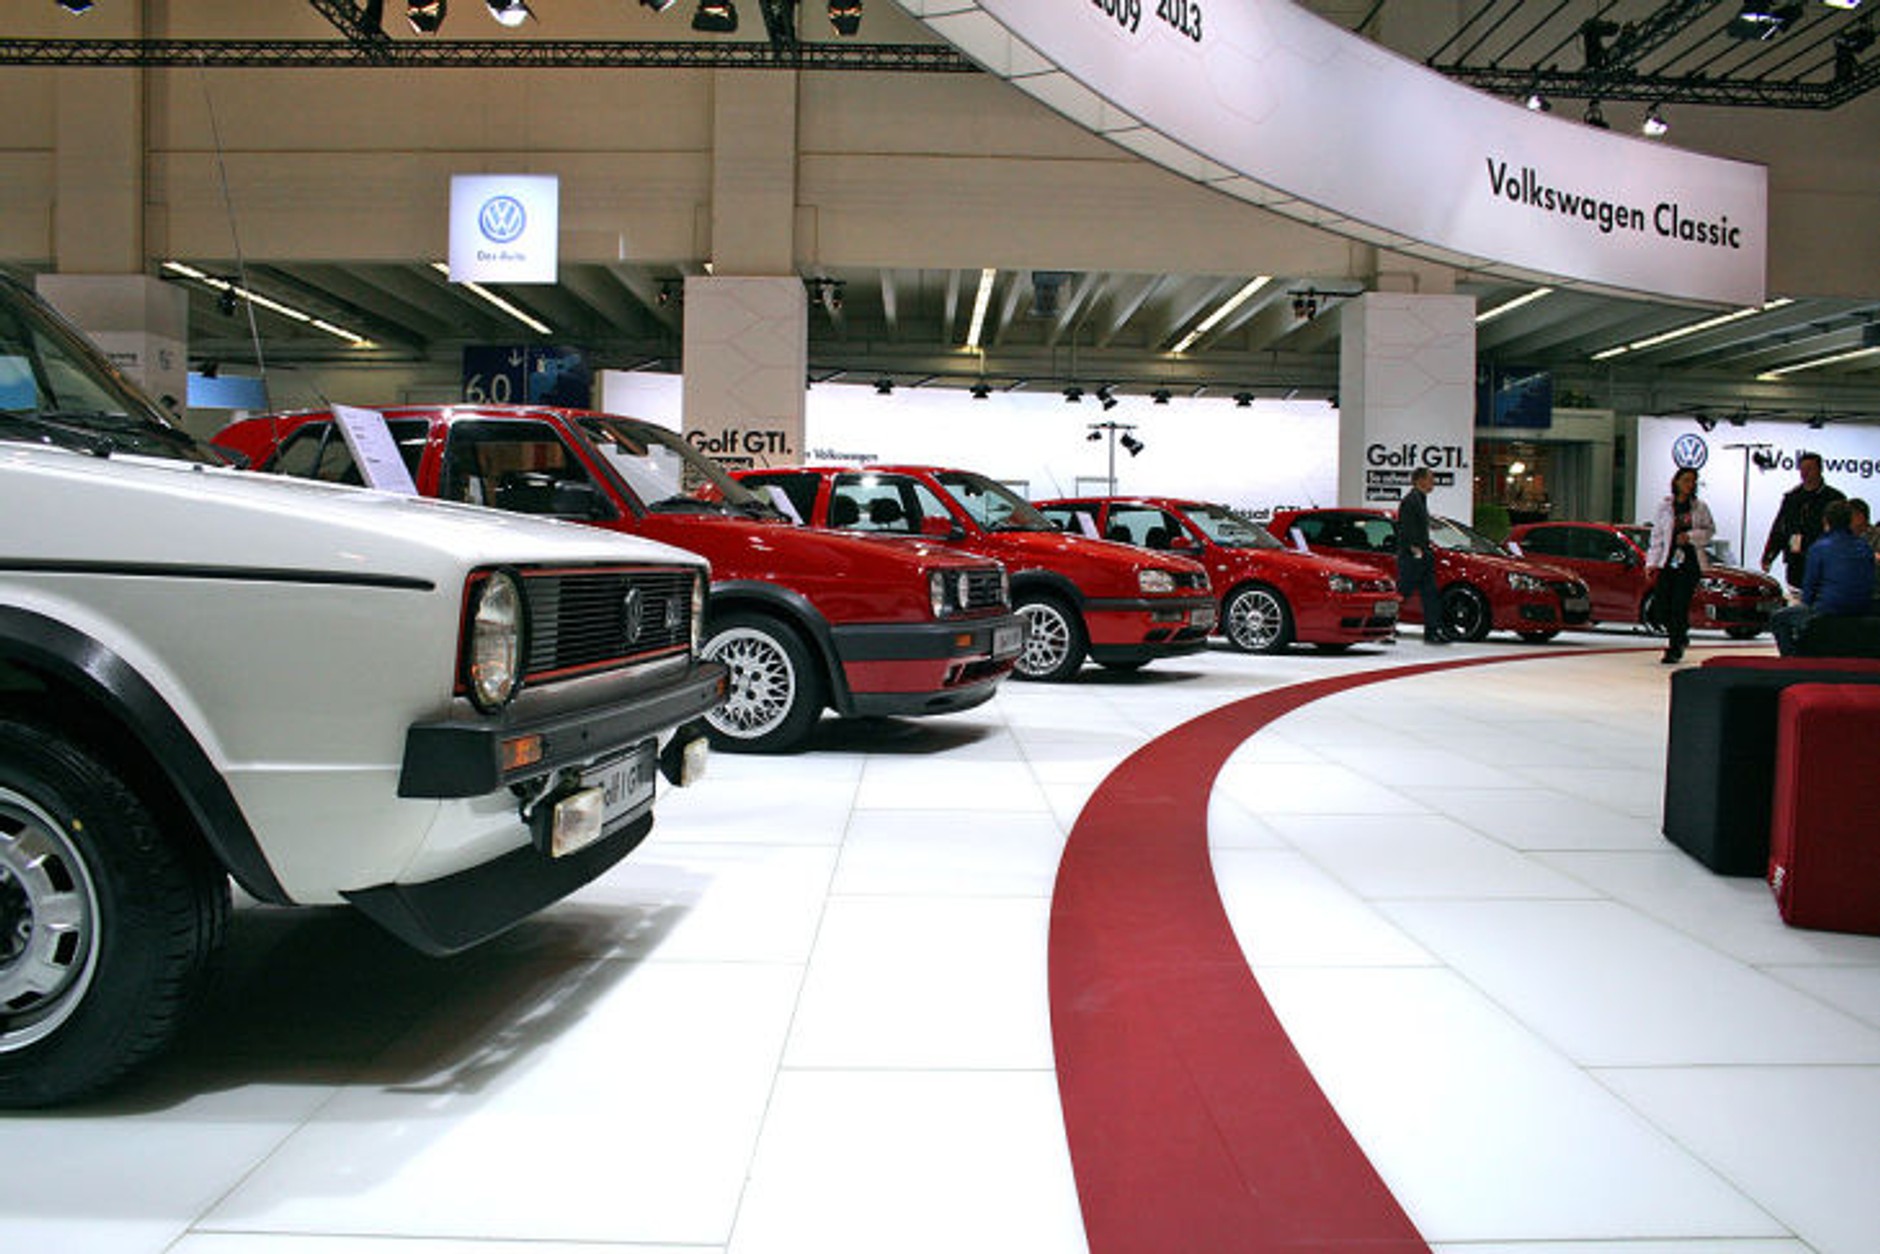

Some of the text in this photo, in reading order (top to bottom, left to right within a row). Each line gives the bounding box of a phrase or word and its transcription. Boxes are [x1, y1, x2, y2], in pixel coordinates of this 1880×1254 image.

[1091, 0, 1140, 33] 09
[1156, 0, 1201, 42] 2013
[1487, 157, 1741, 249] Volkswagen Classic
[466, 373, 512, 404] 6.0
[686, 428, 792, 454] Golf GTI.
[1367, 443, 1469, 468] Golf GTI.
[1766, 449, 1880, 478] Volwag
